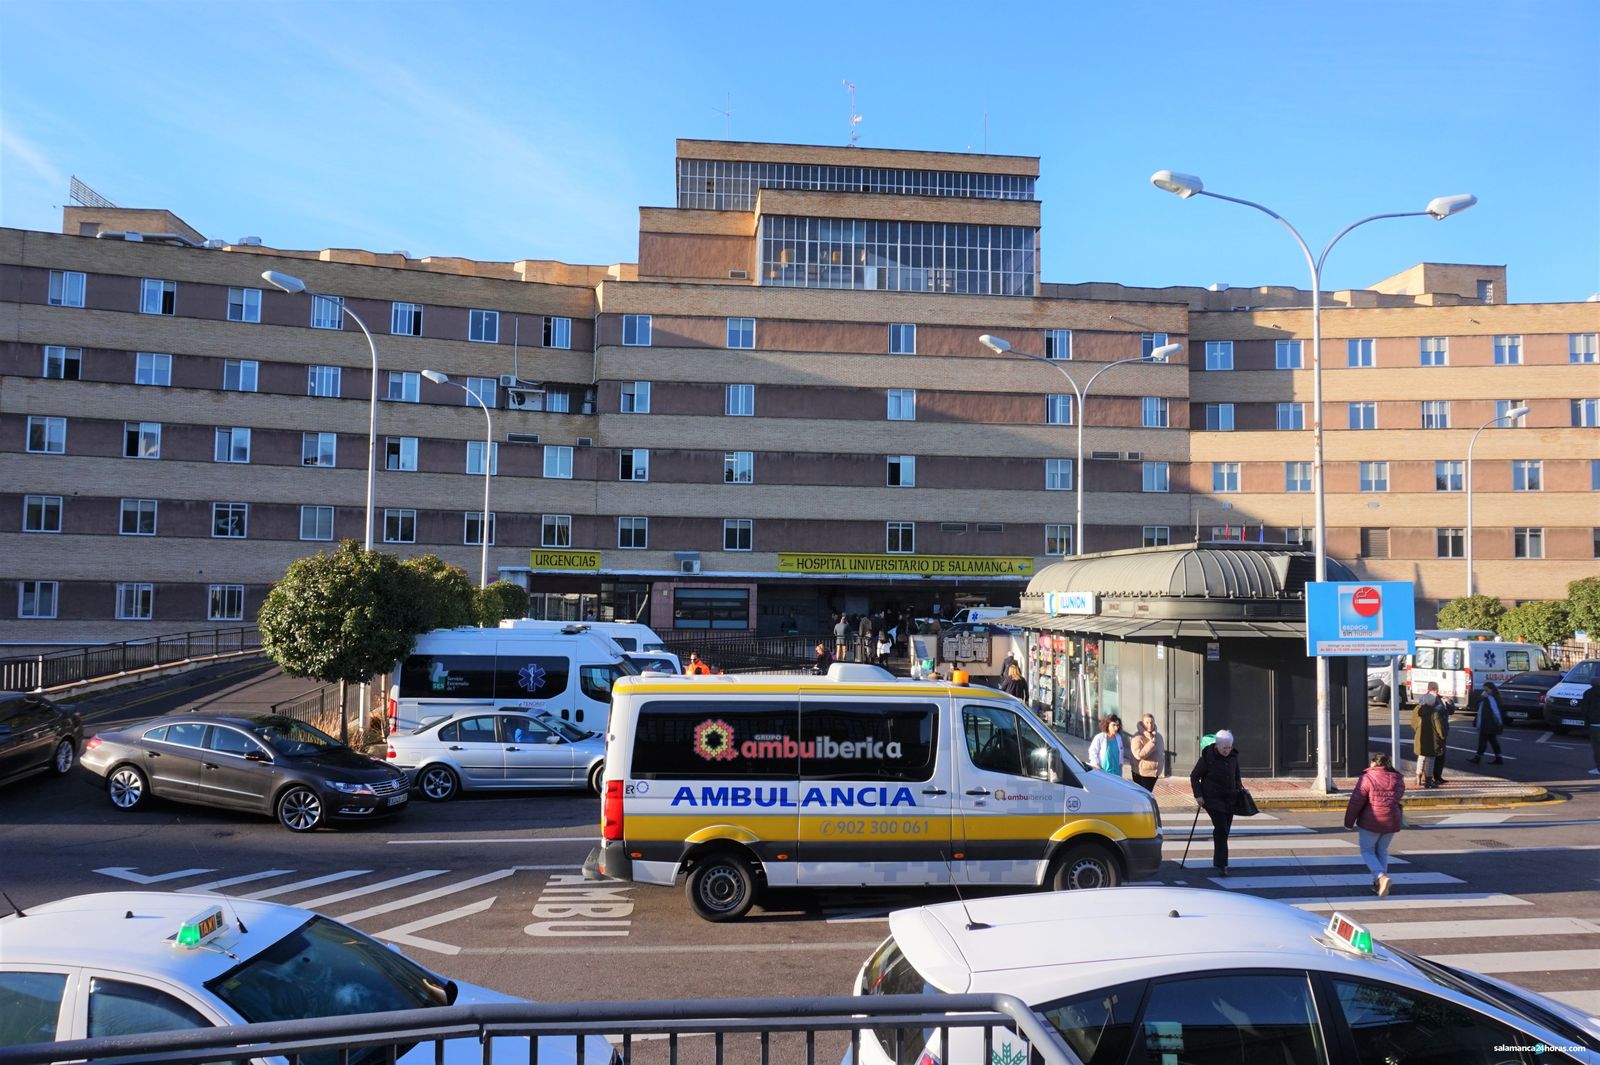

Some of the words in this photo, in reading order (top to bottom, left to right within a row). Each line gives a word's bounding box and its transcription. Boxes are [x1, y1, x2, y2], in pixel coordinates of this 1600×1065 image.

[535, 554, 596, 567] URGENCIAS
[796, 558, 847, 570] HOSPITAL
[849, 559, 929, 572] UNIVERSITARIO
[932, 560, 945, 571] DE
[948, 560, 1014, 572] SALAMANCA
[1060, 596, 1086, 609] ILUNION
[1342, 624, 1368, 632] espacio
[741, 736, 902, 759] ambuiberica
[671, 787, 917, 807] AMBULANCIA
[837, 820, 866, 835] 902
[869, 820, 898, 835] 300
[902, 820, 929, 835] 061
[199, 915, 216, 938] TAXI
